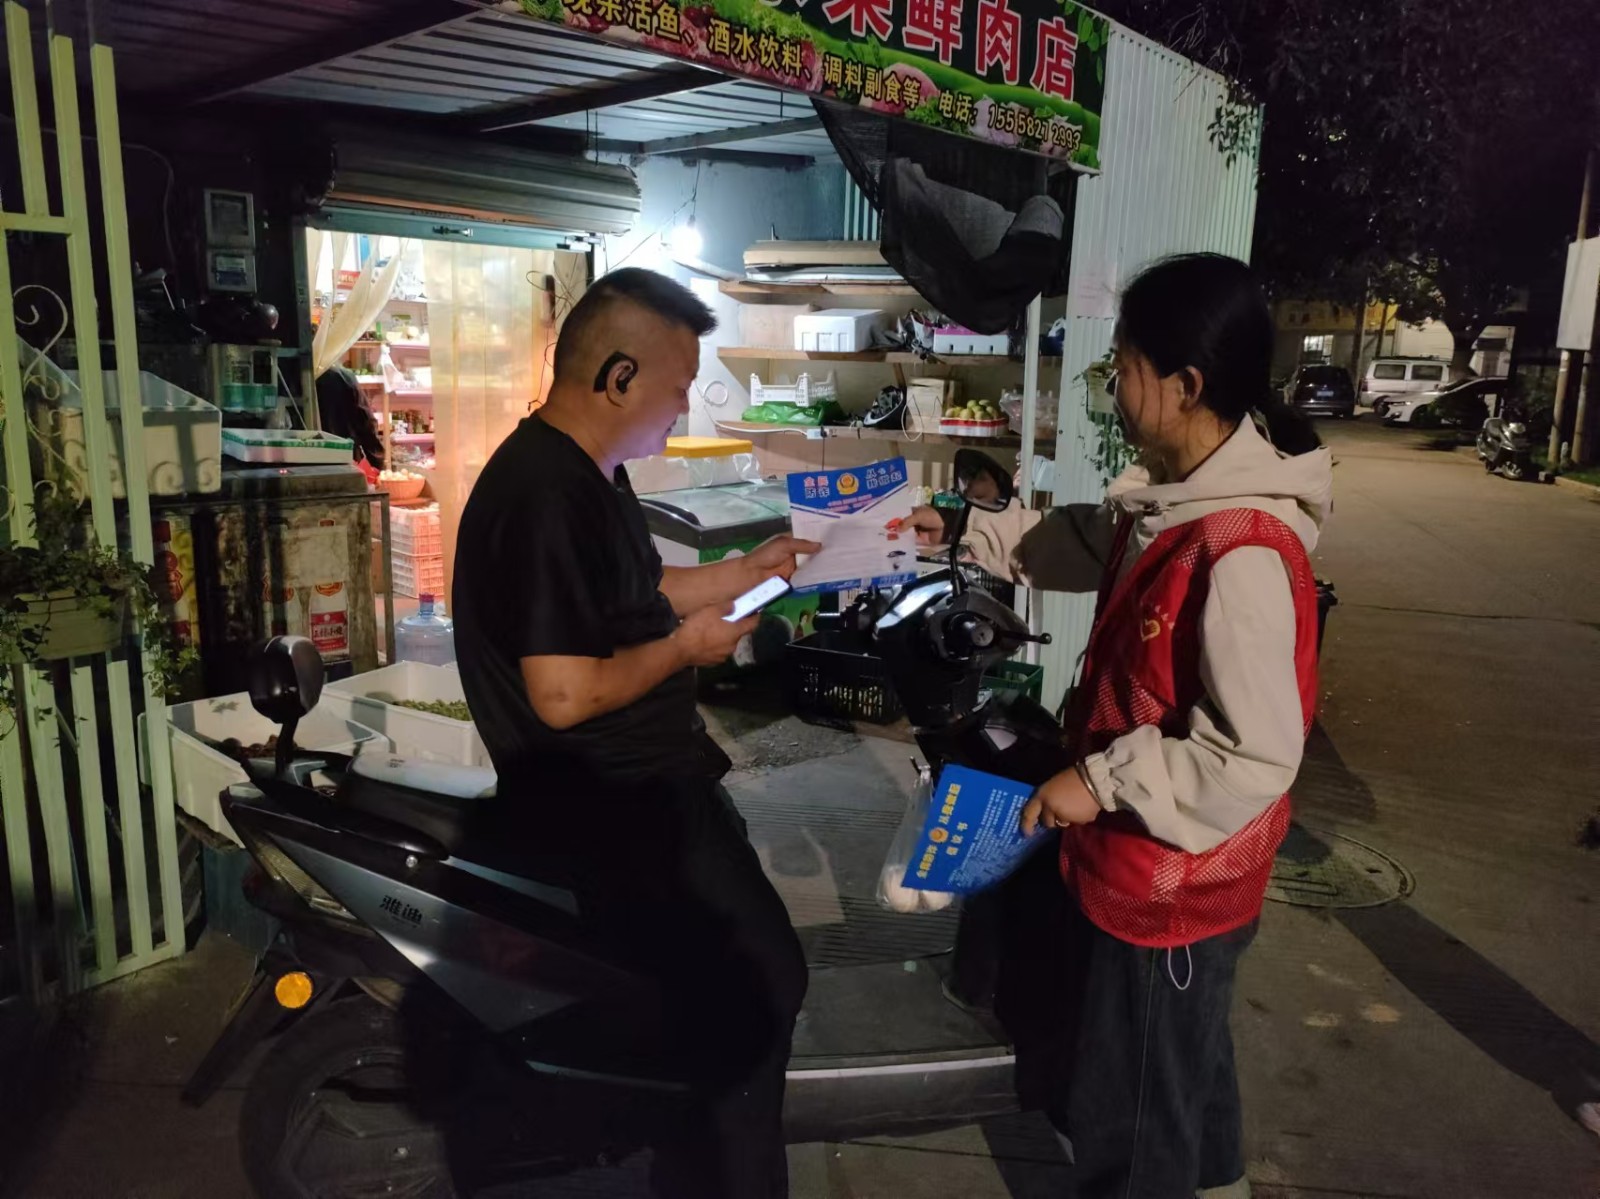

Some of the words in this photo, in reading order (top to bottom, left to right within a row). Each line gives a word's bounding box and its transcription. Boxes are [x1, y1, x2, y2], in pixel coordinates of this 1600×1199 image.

[988, 104, 1014, 131] 155
[1018, 113, 1049, 141] 5827
[1051, 124, 1081, 150] 2993
[379, 894, 423, 925] 雅迪
